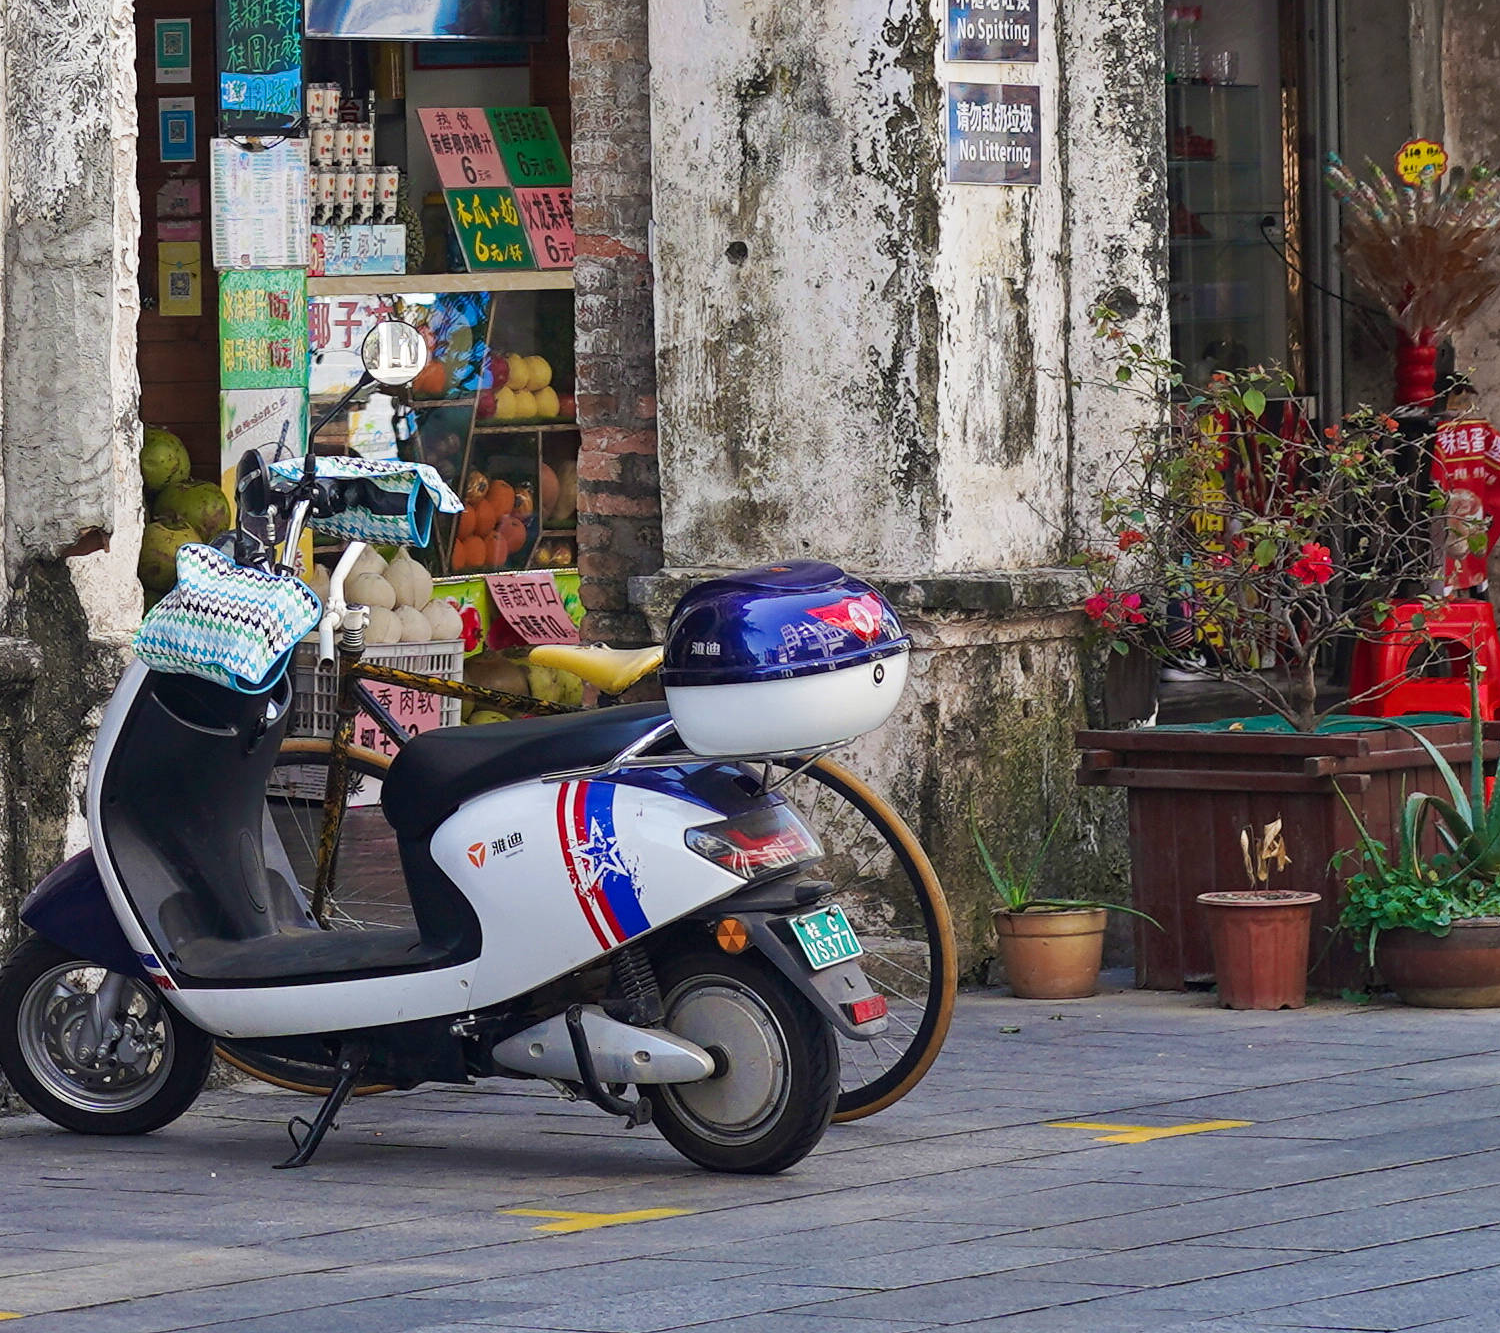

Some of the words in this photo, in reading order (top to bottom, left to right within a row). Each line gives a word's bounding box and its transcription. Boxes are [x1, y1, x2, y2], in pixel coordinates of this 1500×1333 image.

[957, 18, 974, 40] No
[977, 17, 1030, 46] Spitting
[434, 111, 473, 131] 热饮
[956, 100, 1034, 134] 请勿乱扔垃圾
[959, 138, 976, 162] No
[980, 139, 1031, 170] Littering
[691, 640, 721, 656] 雅迪
[491, 831, 524, 857] 雅迪
[826, 915, 841, 933] C
[807, 930, 860, 964] VS377
